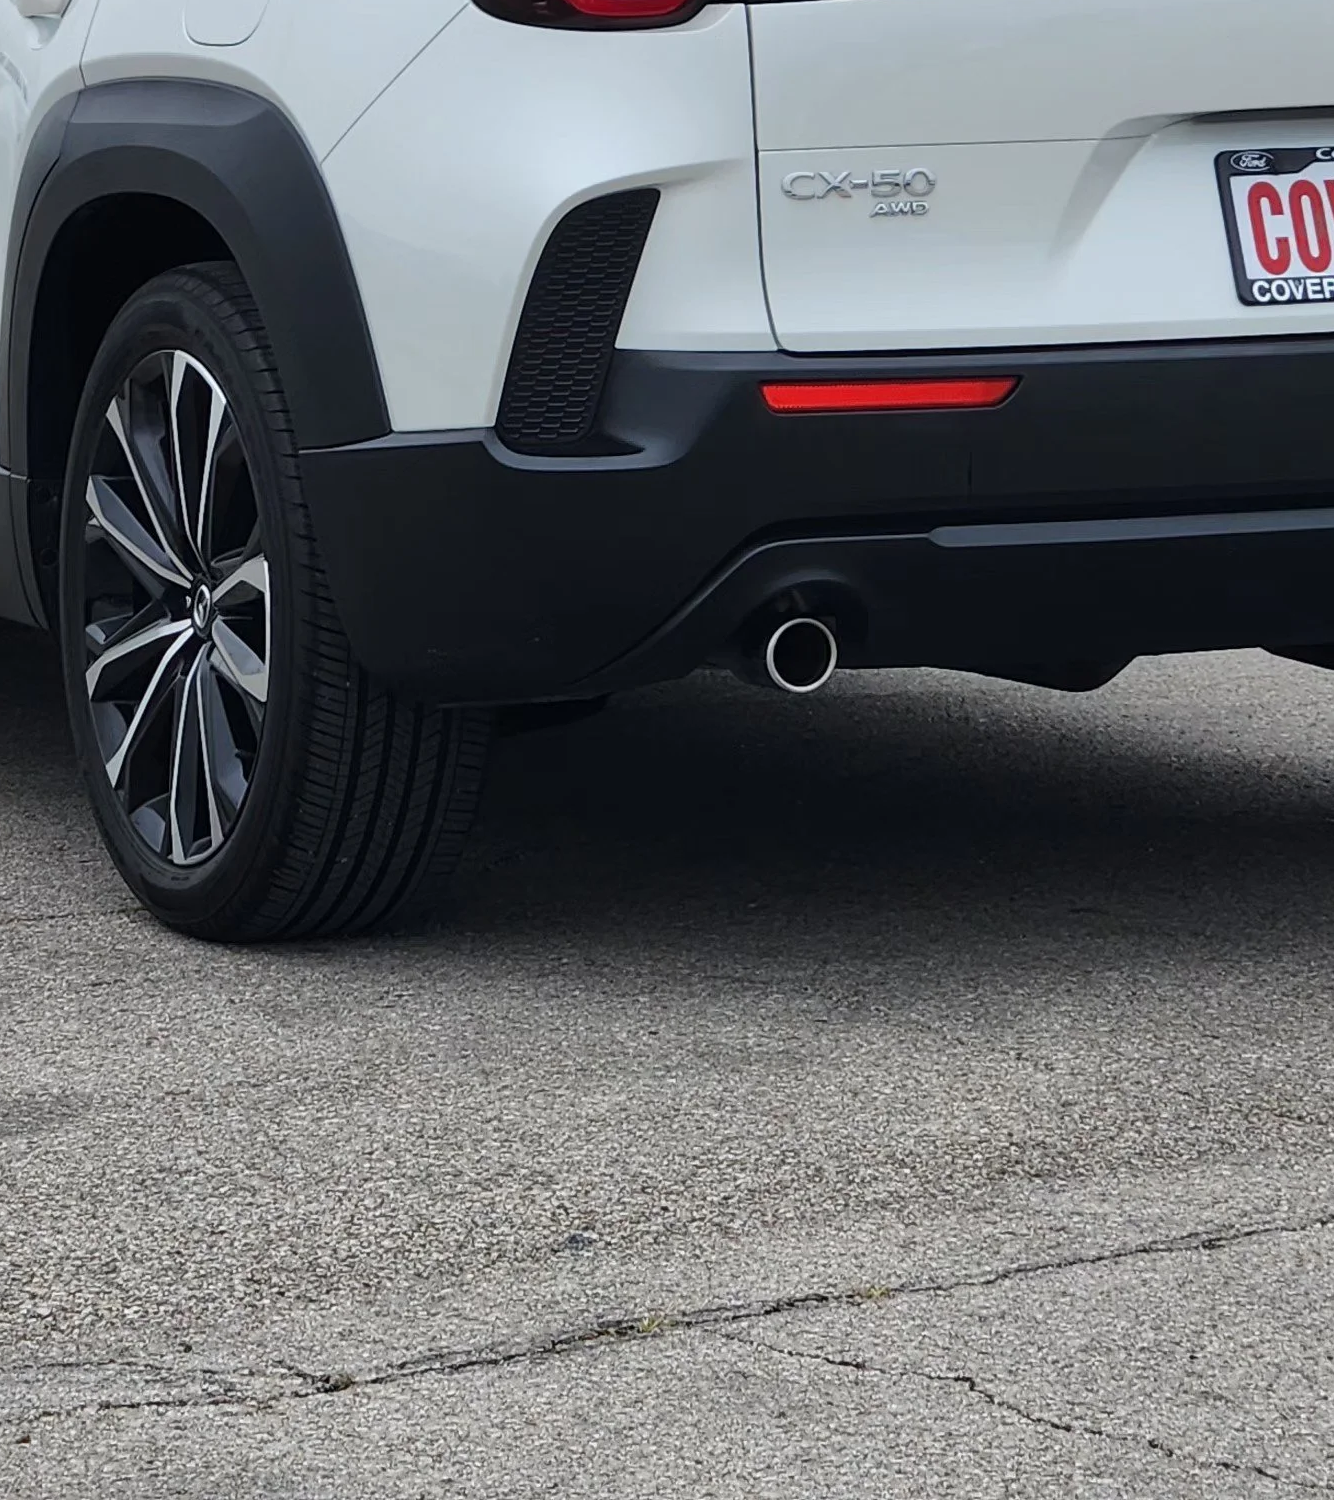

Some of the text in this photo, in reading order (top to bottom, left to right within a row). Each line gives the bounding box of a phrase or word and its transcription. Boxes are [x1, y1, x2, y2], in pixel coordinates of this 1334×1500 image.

[1239, 154, 1267, 167] Ford
[781, 167, 936, 200] CX-50
[870, 201, 929, 218] AWD
